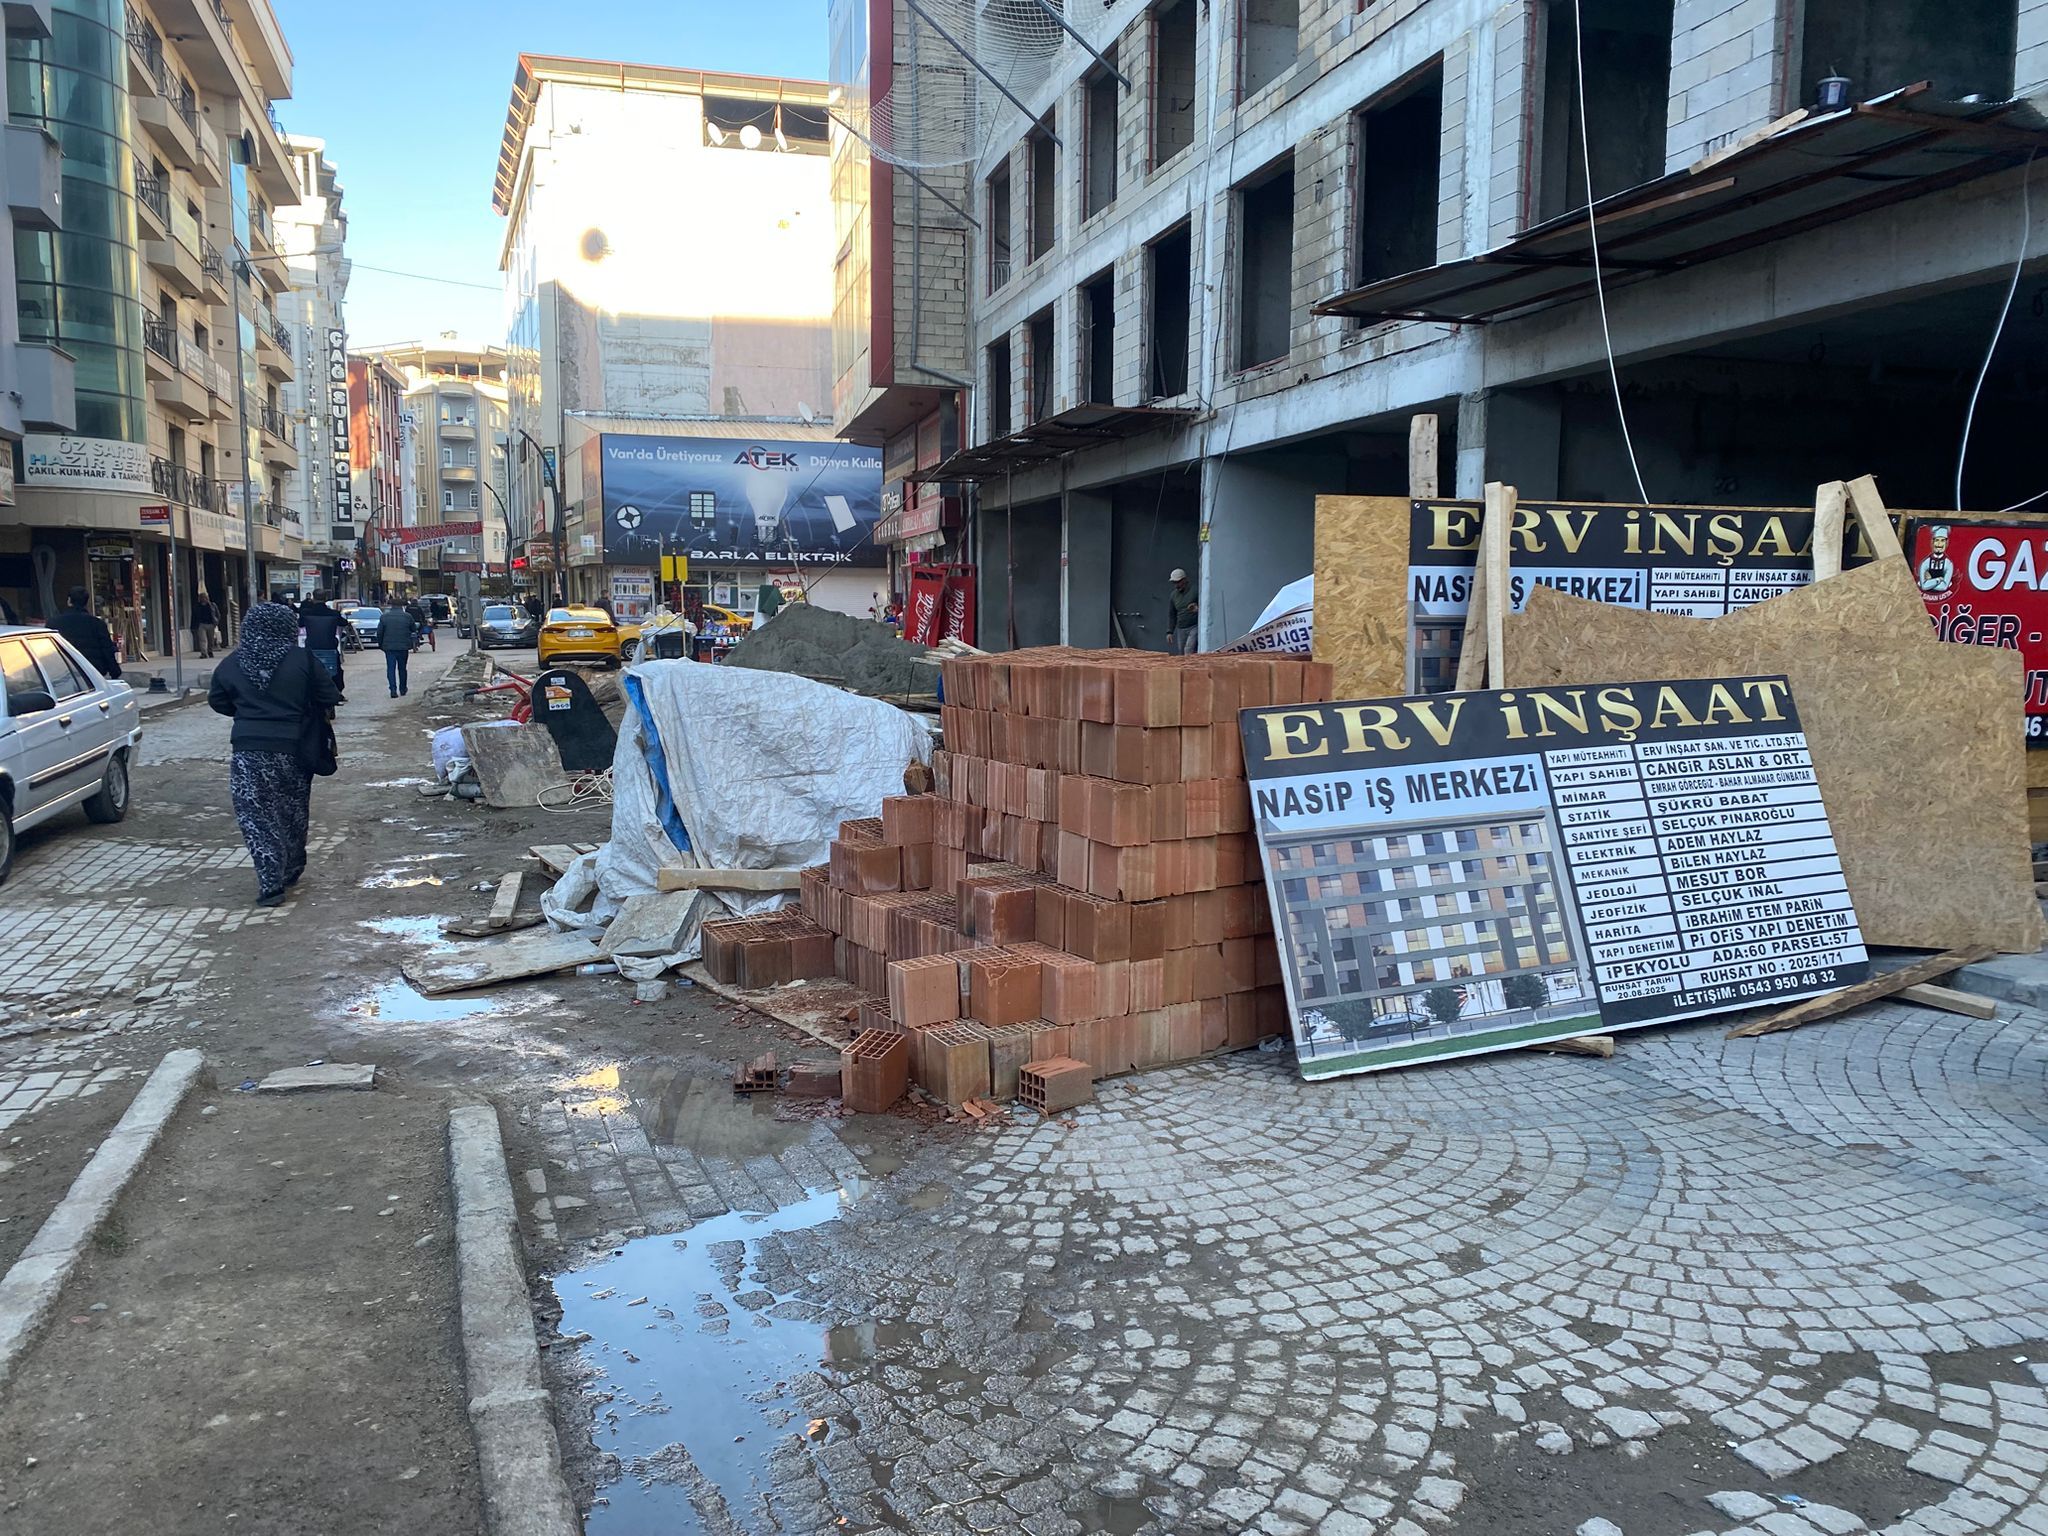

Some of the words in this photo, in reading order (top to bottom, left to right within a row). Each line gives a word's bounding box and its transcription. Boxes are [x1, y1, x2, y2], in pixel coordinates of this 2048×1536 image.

[60, 437, 87, 455] ÖZ
[608, 447, 654, 462] Van'da
[656, 446, 722, 464] Üretiyoruz
[30, 453, 105, 470] HAZIR
[733, 450, 799, 468] ATEK
[810, 455, 849, 470] Dünya
[335, 461, 350, 519] OTEL
[1427, 506, 1599, 554] ERV
[690, 550, 759, 560] BARLA
[765, 550, 852, 562] ELEKTRİK
[1968, 537, 2048, 591] GA
[1655, 571, 1672, 581] YAPI
[1734, 572, 1752, 582] ERV
[1755, 570, 1788, 583] İNŞAAT
[1790, 572, 1811, 582] SAN.
[1415, 574, 1473, 603] NASi
[1655, 589, 1680, 598] YAPI
[1257, 698, 1467, 761] ERV
[1642, 745, 1662, 756] ERV
[1665, 743, 1701, 756] İNŞAAT
[1704, 741, 1728, 752] SAN.
[1729, 740, 1742, 749] VE
[1550, 753, 1571, 764] YAPI
[1708, 756, 1754, 771] ASLAN
[1759, 755, 1769, 767] &
[1773, 752, 1805, 766] ORT.
[1554, 772, 1585, 783] YAPI
[1651, 781, 1678, 794] EMRAH
[1719, 776, 1743, 788] BAHAR
[1776, 770, 1811, 782] GÜNBATAR
[1562, 790, 1607, 803] MİMAR
[1657, 795, 1714, 814] ŞÜKRÜ
[1719, 793, 1769, 806] BABAT
[1567, 808, 1612, 822] STATİK
[1661, 815, 1718, 831] SELÇUK
[1721, 808, 1796, 827] PINAROĞLU
[1571, 826, 1619, 843] ŞANTİYE
[1623, 823, 1647, 838] ŞEFİ
[1667, 834, 1706, 851] ADEM
[1711, 829, 1763, 846] HAYLAZ
[1576, 844, 1637, 860] ELEKTRİK
[1716, 848, 1767, 865] HAYLAZ
[1676, 871, 1729, 889] MESUT
[1735, 866, 1767, 881] BOR
[1586, 883, 1638, 900] JEOLOJİ
[1682, 887, 1744, 907] SELÇUK
[1590, 903, 1648, 920] JEOFİZİK
[1748, 903, 1783, 919] ETEM
[1595, 923, 1642, 939] HARİTA
[1748, 922, 1782, 939] YAPI
[1599, 947, 1625, 959] YAPI
[1628, 938, 1675, 955] DENETİM
[1712, 944, 1768, 963] ADA:60
[1771, 932, 1849, 955] PARSEL:57
[1701, 965, 1753, 985] RUHSAT
[1758, 961, 1777, 975] NO
[1789, 951, 1844, 970] 2025/171
[1605, 981, 1642, 993] RUHSAT
[1740, 980, 1772, 996] 0543
[1776, 975, 1799, 990] 950
[1802, 972, 1818, 986] 48
[1821, 969, 1837, 983] 32
